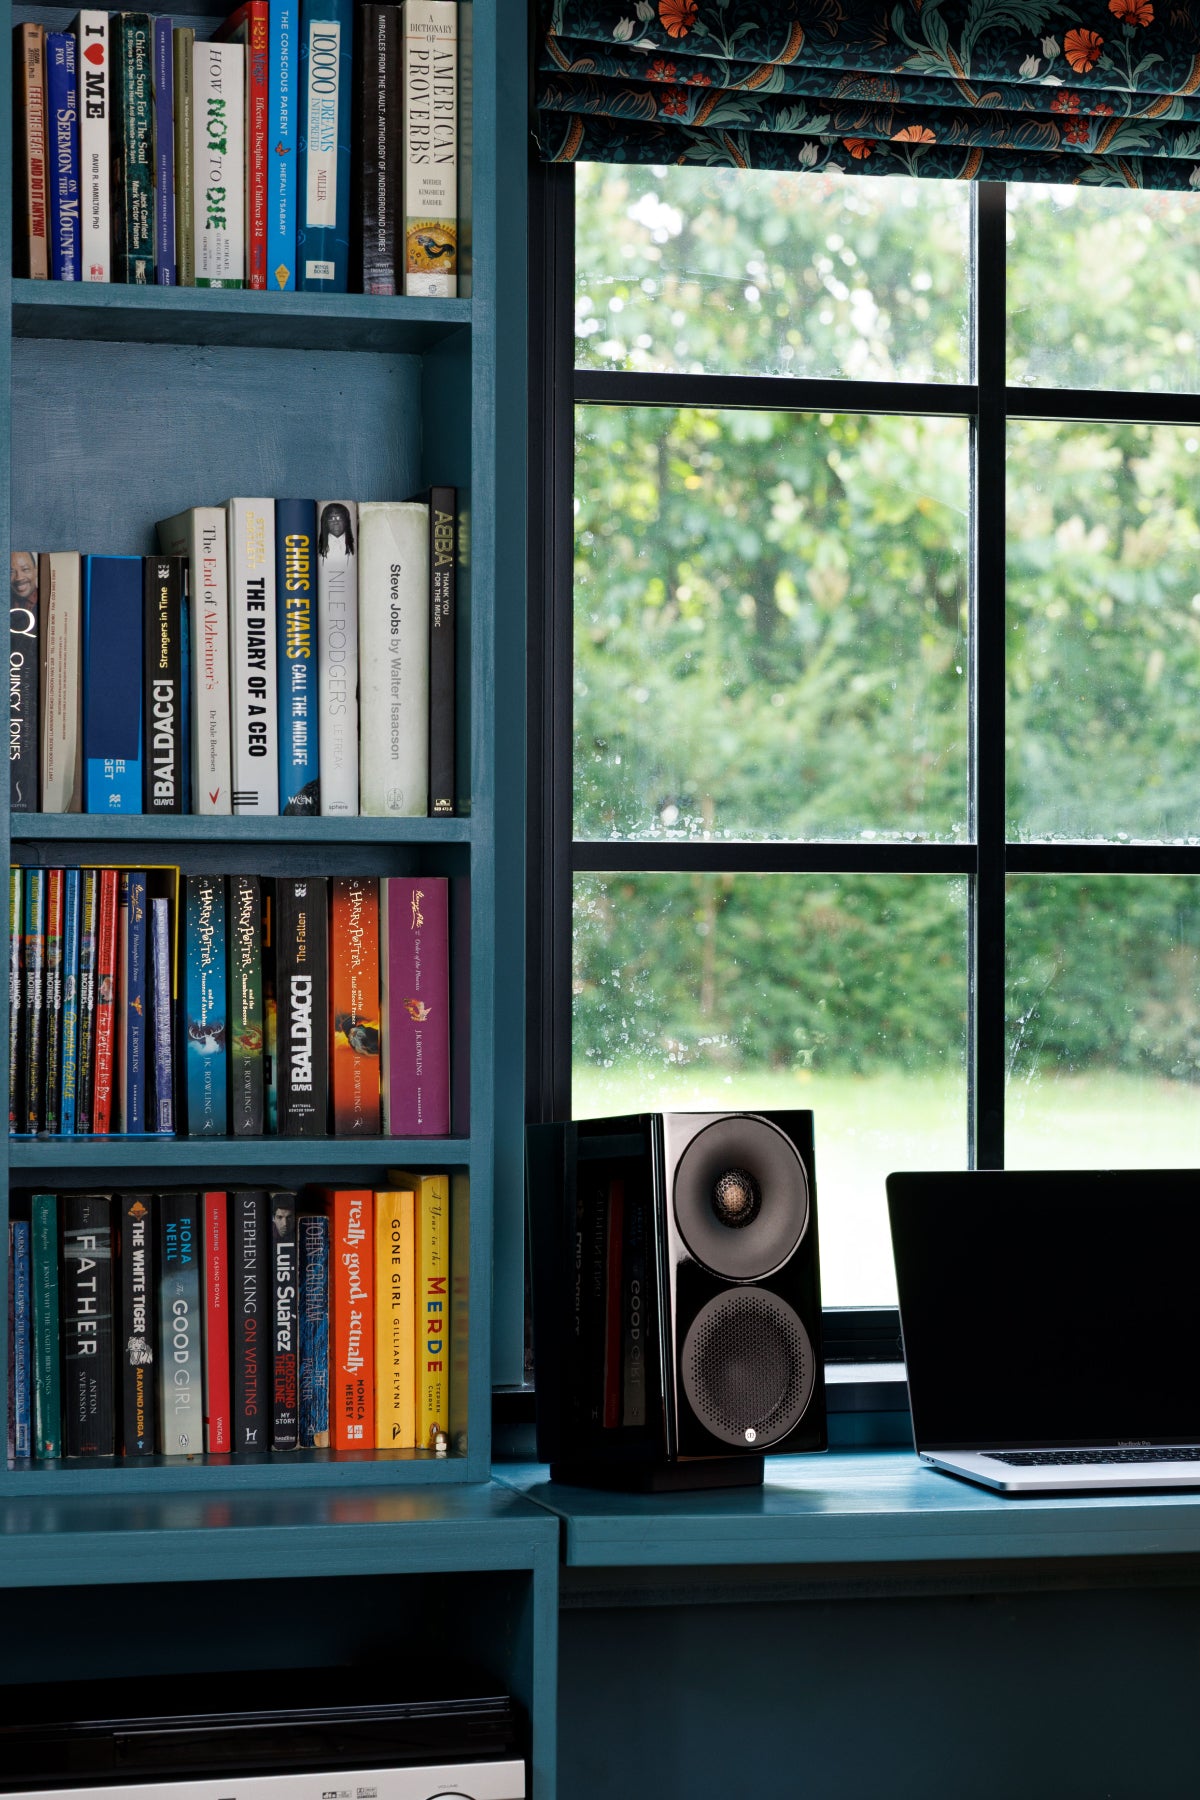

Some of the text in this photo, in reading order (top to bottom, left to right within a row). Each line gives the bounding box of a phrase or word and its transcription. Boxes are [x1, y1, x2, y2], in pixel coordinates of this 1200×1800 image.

[56, 48, 64, 65] FOX
[66, 41, 74, 74] EMMET
[86, 24, 104, 119] I ME
[134, 31, 148, 164] Chicken Soup For The Soul
[280, 33, 288, 92] CONSCIOUS
[310, 32, 337, 94] 10,000
[56, 90, 76, 174] THE SERMON
[206, 49, 228, 230] HOW NOT TO DIE
[280, 96, 288, 136] PARENT
[310, 98, 321, 151] INTERPRETED
[320, 99, 334, 152] DREAMS
[409, 48, 430, 164] PROVERBS
[434, 49, 454, 165] AMERICAN
[59, 177, 68, 195] THE
[60, 198, 78, 256] MOUNT
[68, 180, 76, 192] ON
[316, 169, 328, 202] MILLER
[434, 510, 453, 567] ABBA
[202, 526, 219, 690] The End of Alzheimer's
[286, 534, 311, 659] CHRIS EVANS
[246, 578, 267, 757] THE DIARY OF A CEO
[387, 564, 402, 760] Steve Jobs by Walter Isaacson
[152, 680, 174, 798] BALDACCI
[292, 664, 308, 766] CALL THE MIDLIFE
[239, 890, 254, 968] HARRY POTTER
[350, 892, 364, 970] HARRY POTTER
[290, 976, 312, 1082] BALDACCI
[132, 1220, 146, 1332] THE WHITE TIGER
[166, 1224, 178, 1260] NEILL
[180, 1218, 191, 1264] FIONA
[391, 1220, 400, 1264] GONE
[77, 1236, 97, 1356] FATHER
[242, 1201, 258, 1416] STEPHEN KING ON WRITING
[276, 1242, 296, 1352] Luis Suárez
[342, 1200, 368, 1375] really good, actually
[392, 1274, 400, 1310] GIRL
[428, 1277, 446, 1372] MERDE
[172, 1300, 190, 1415] GOOD GIRL
